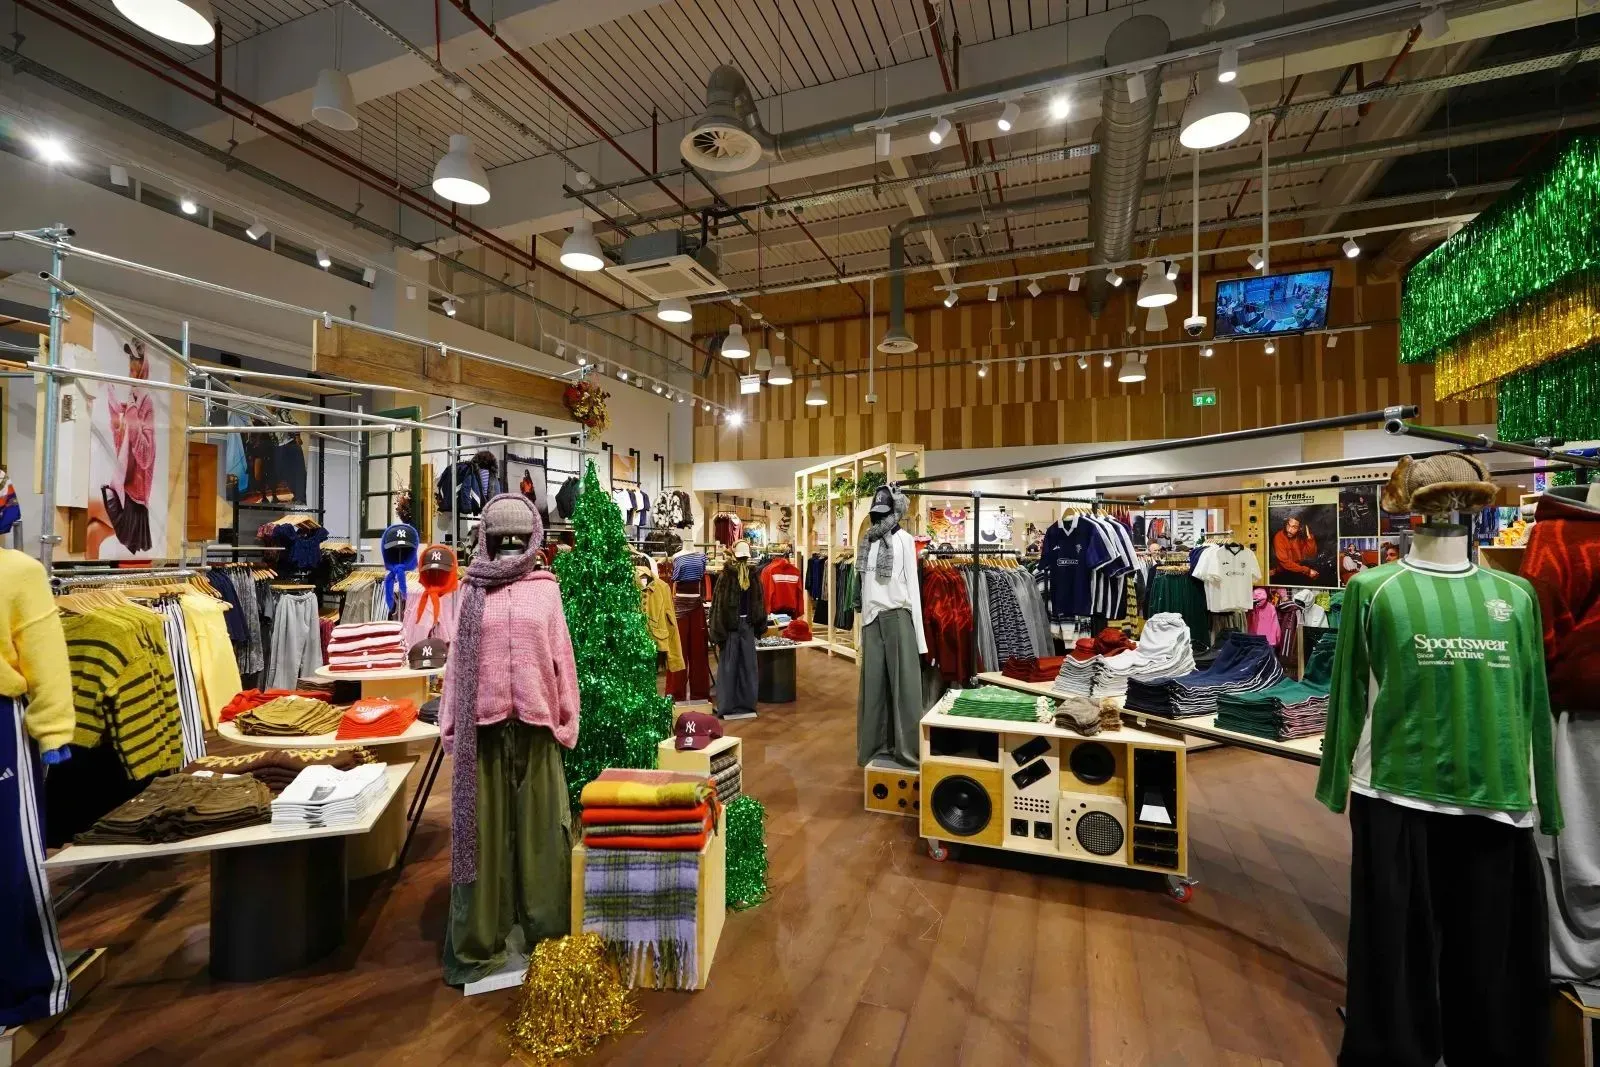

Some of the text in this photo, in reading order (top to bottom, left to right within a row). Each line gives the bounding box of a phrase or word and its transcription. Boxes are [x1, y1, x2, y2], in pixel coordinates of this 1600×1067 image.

[396, 529, 406, 538] NY
[431, 551, 442, 561] NY
[1413, 633, 1509, 652] Sportswear
[422, 645, 433, 657] NY
[1443, 648, 1485, 660] Archive
[685, 720, 696, 733] NY
